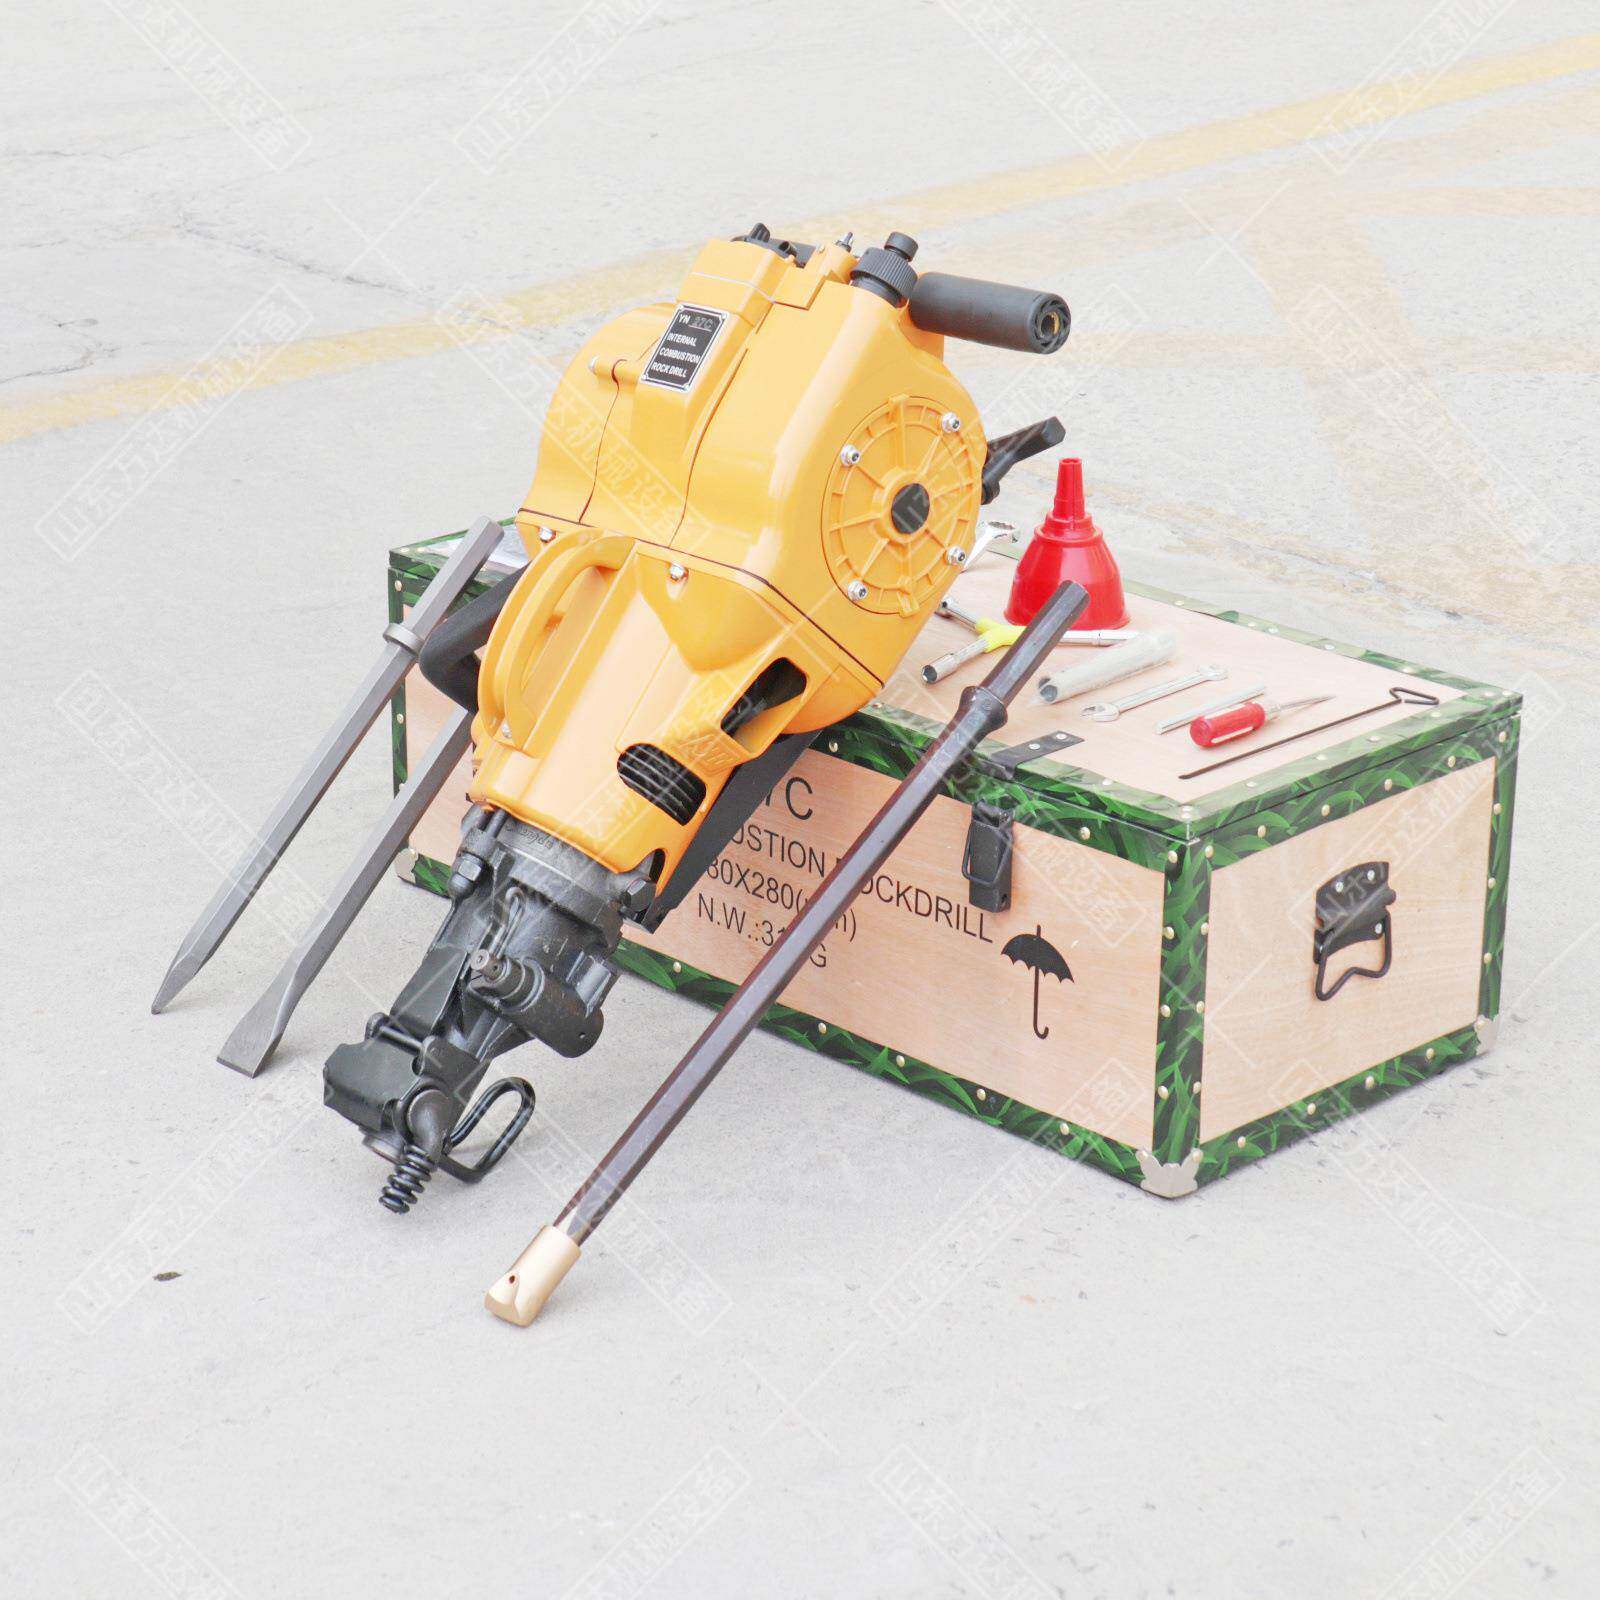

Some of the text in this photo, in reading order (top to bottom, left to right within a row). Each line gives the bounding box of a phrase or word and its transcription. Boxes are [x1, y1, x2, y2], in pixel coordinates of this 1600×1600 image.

[678, 313, 691, 324] YN
[666, 332, 697, 347] INTERNAL
[659, 347, 701, 363] COMBUSTION
[651, 362, 687, 378] ROCK DRILL
